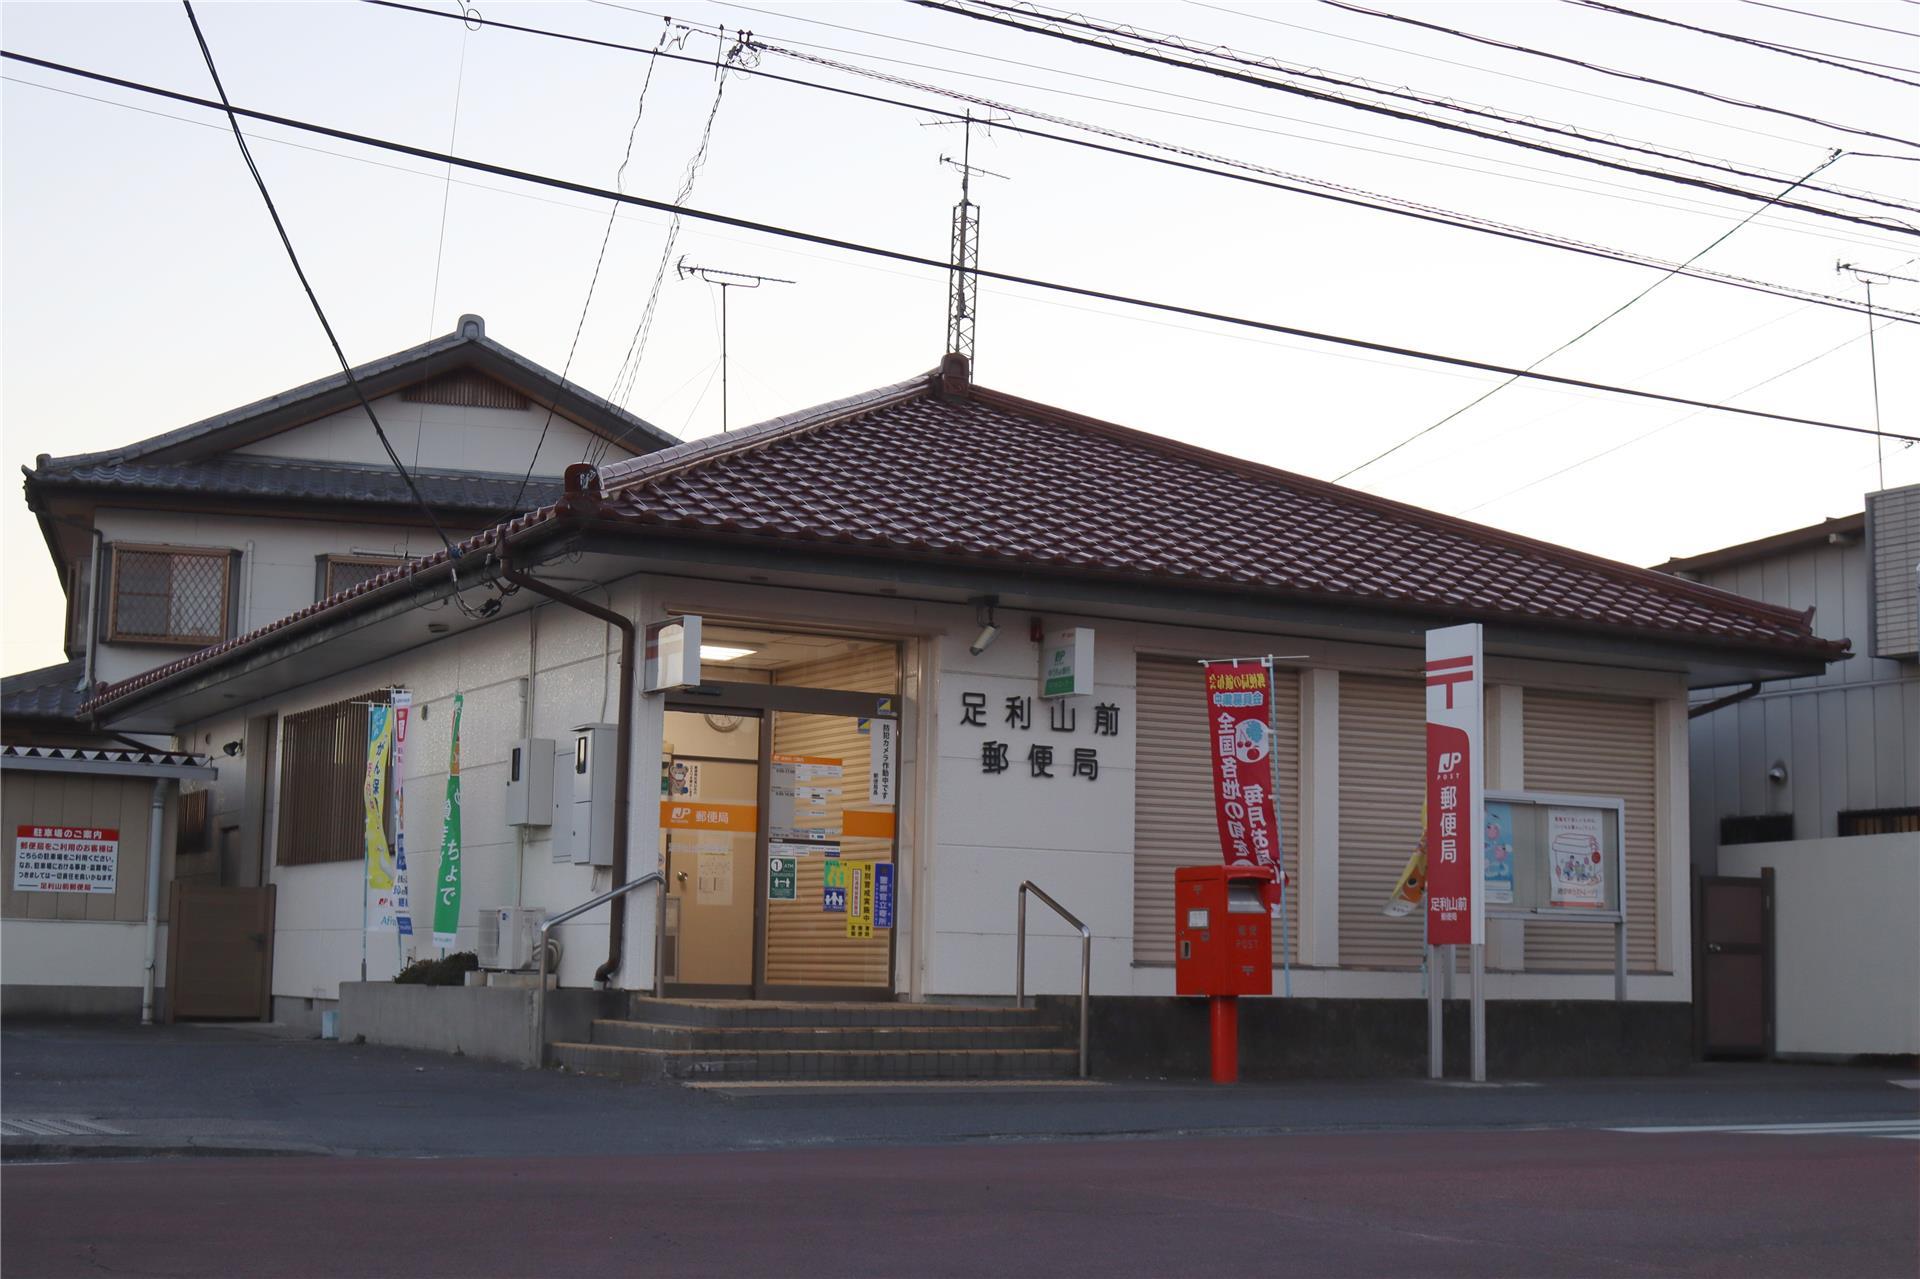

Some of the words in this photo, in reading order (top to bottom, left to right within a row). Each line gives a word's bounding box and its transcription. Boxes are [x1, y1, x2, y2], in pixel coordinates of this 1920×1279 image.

[960, 691, 1121, 736] 足利山前
[980, 739, 1101, 781] 郵便局
[1437, 772, 1462, 781] POST
[695, 810, 730, 825] 郵便局
[1439, 785, 1458, 864] 郵便局
[33, 827, 103, 840] 駐車場のご案内
[20, 841, 114, 853] 郵便局をご利用のお客様は
[19, 852, 114, 863] こちらの駐車場をご利用ください。
[39, 882, 92, 892] 足利山前郵便局
[1430, 896, 1468, 912] 足利山前
